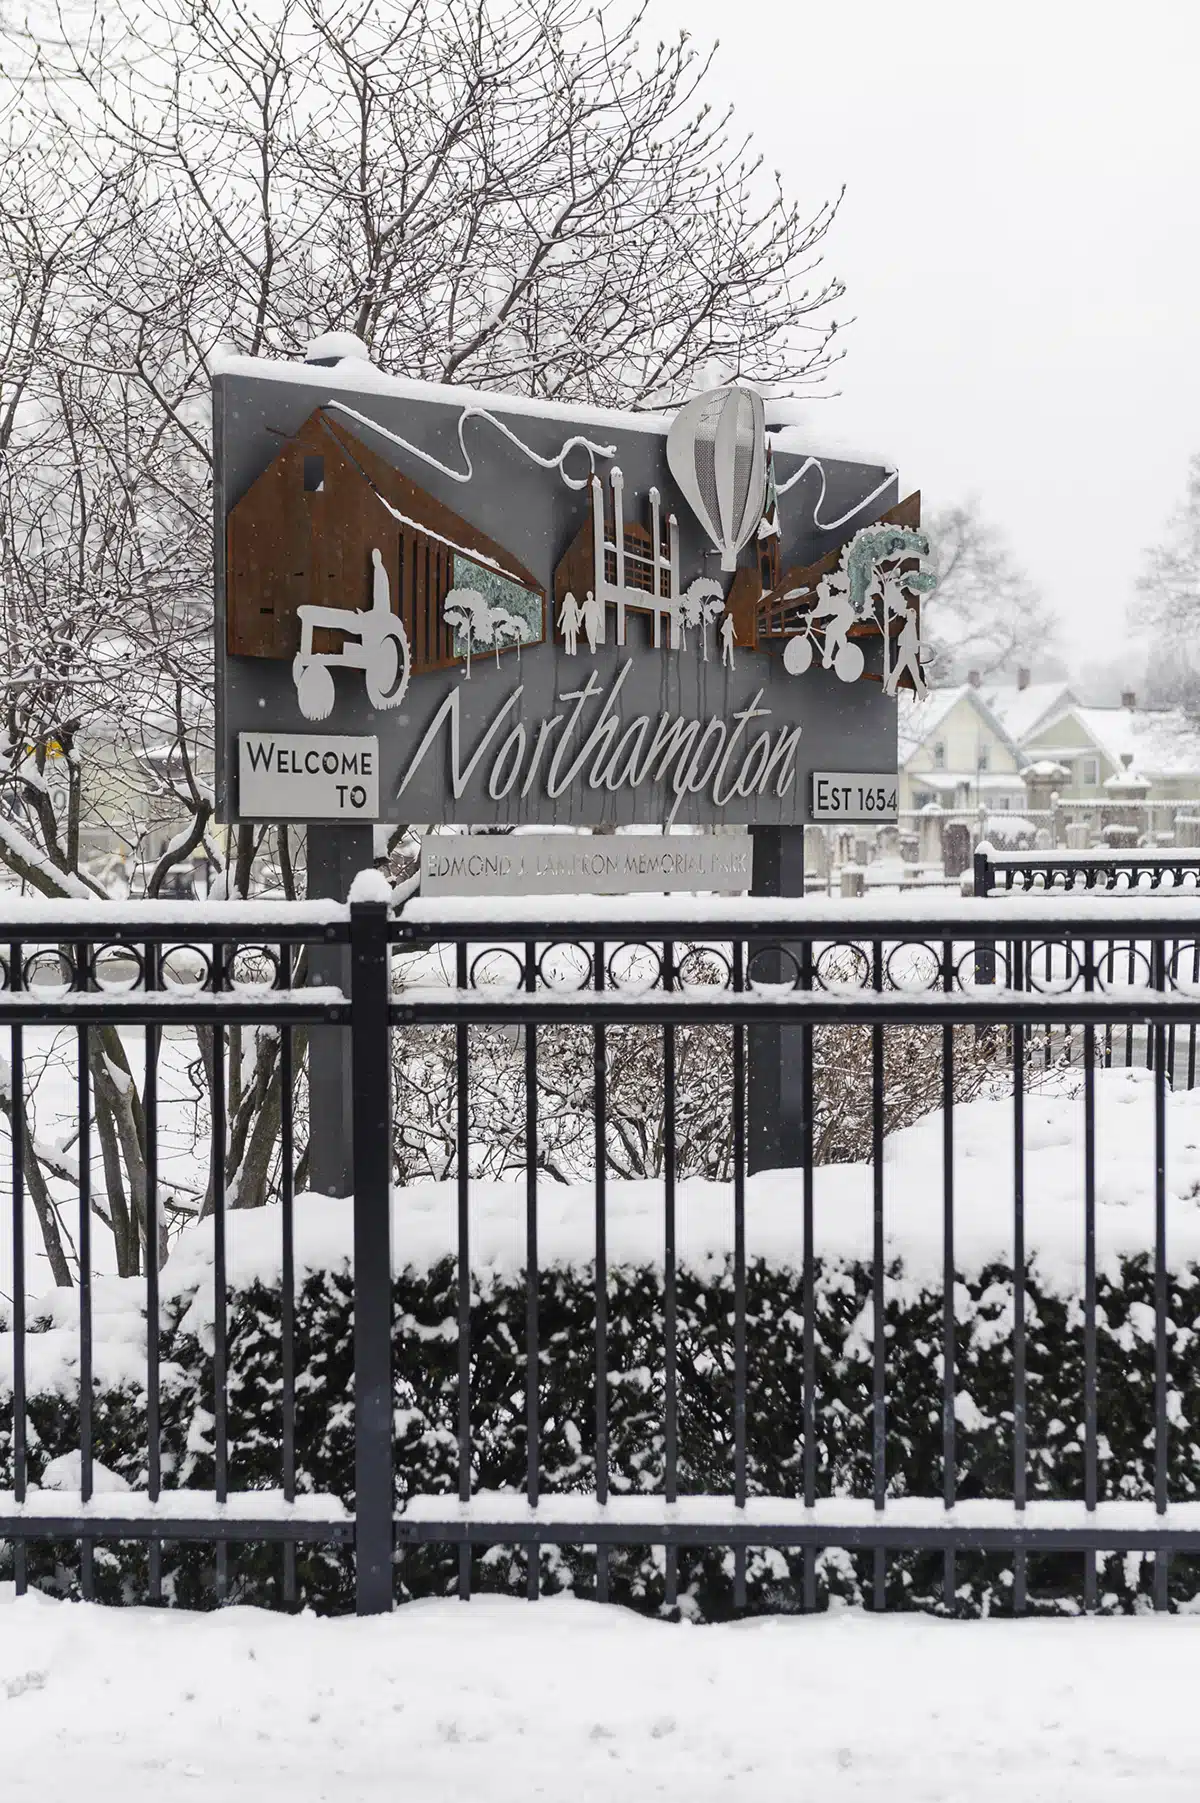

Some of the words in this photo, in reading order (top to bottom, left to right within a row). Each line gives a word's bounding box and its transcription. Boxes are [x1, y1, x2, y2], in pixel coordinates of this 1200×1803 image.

[246, 741, 373, 776] WELCOME
[396, 658, 802, 835] Northampton
[335, 785, 367, 809] TO
[817, 780, 852, 811] EST
[857, 788, 898, 811] 1654
[427, 853, 511, 878] EDMOND
[622, 852, 706, 877] MEMORIAL
[711, 852, 748, 874] PARK
